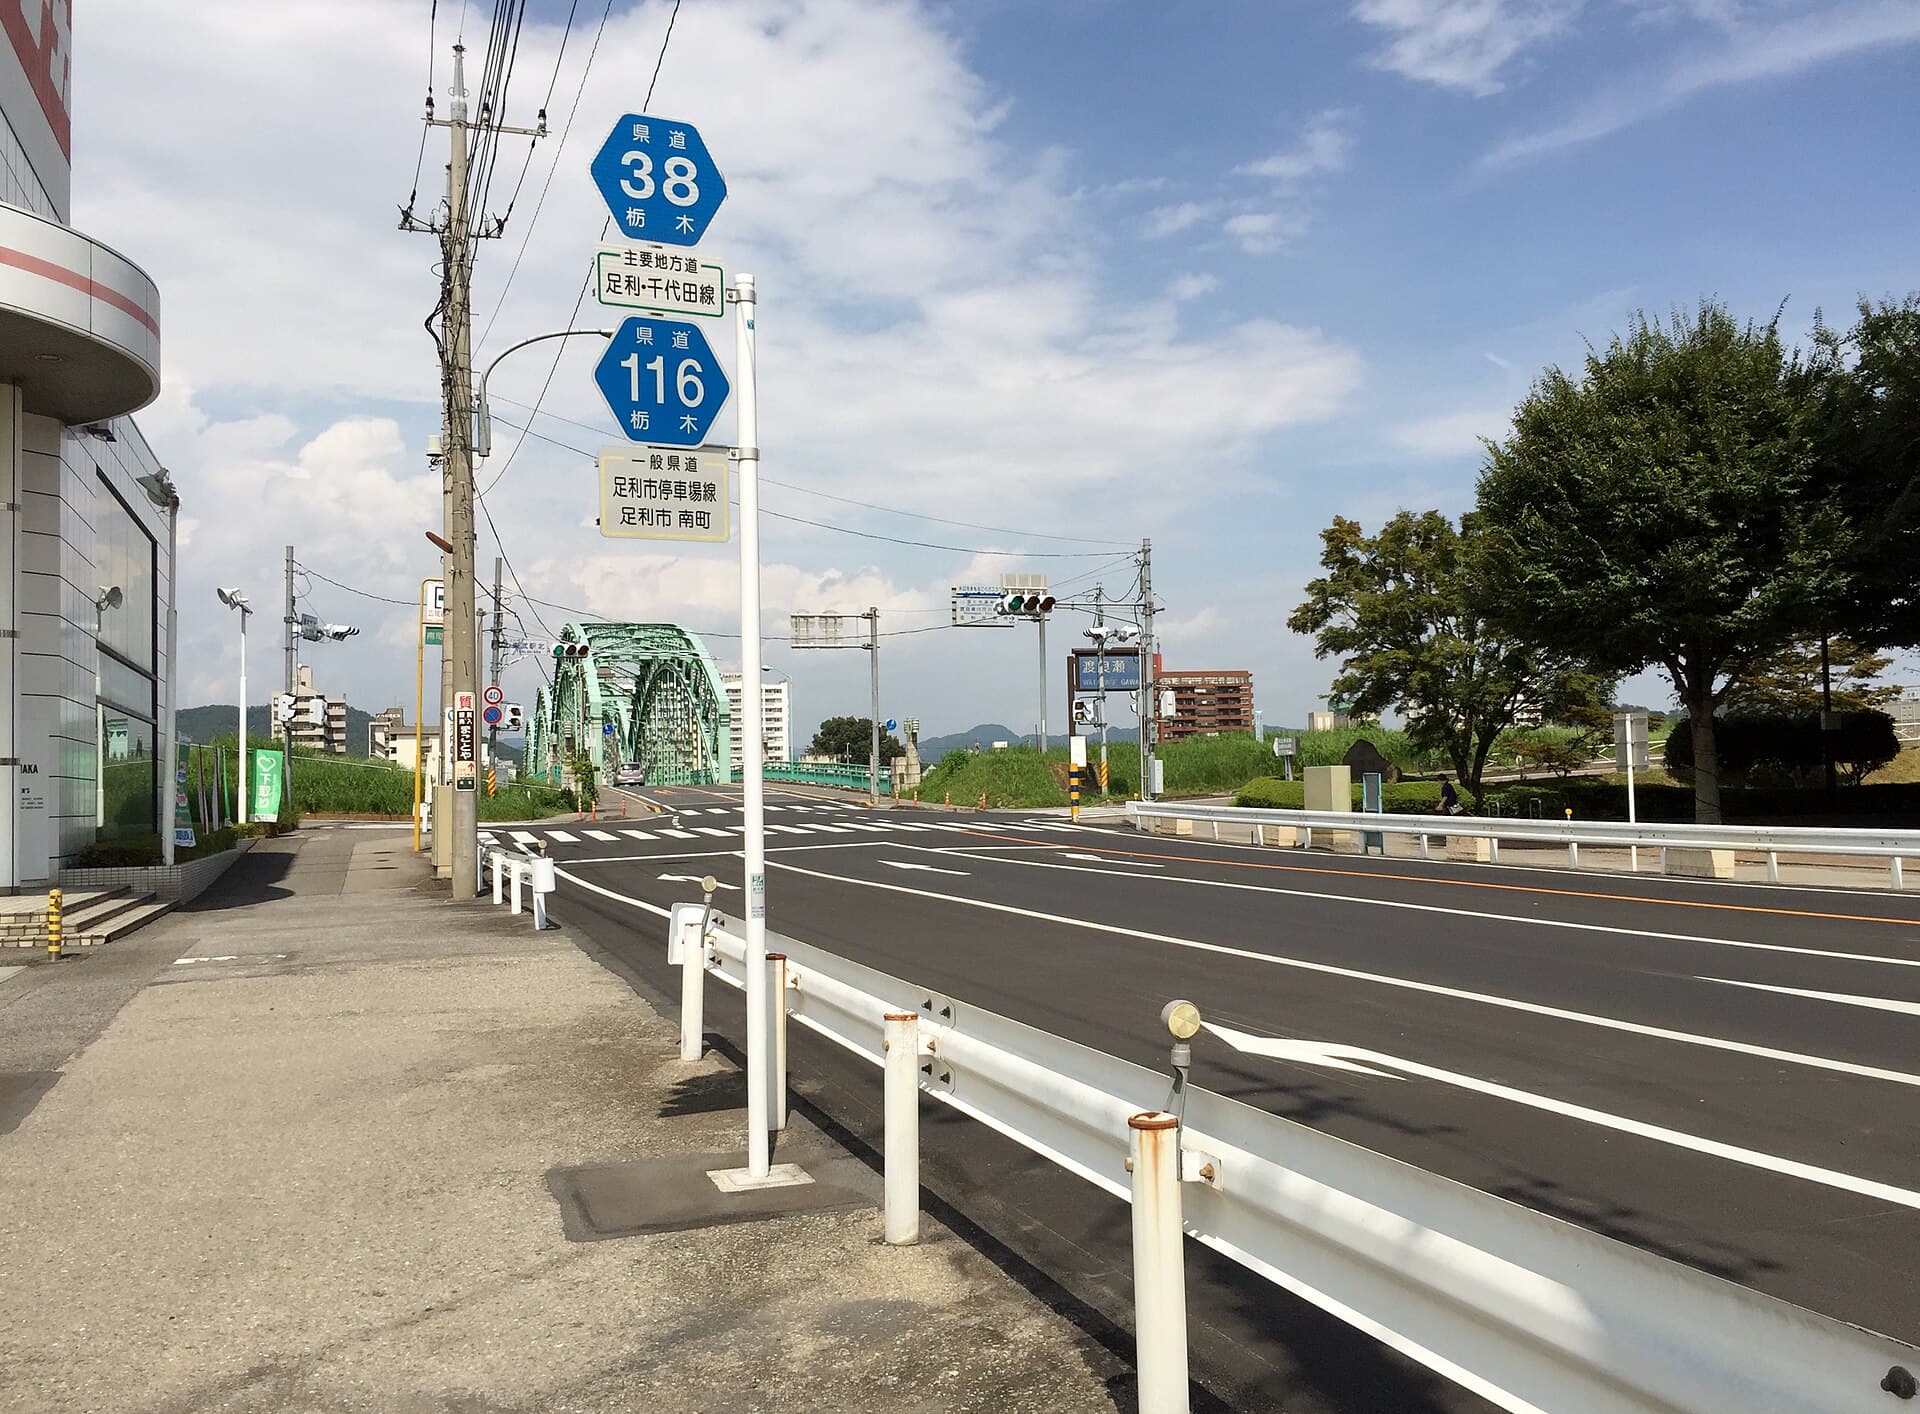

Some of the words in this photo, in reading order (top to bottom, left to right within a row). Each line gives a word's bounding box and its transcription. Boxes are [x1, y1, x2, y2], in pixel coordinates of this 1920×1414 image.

[632, 123, 687, 149] 県道
[619, 150, 700, 207] 38
[626, 207, 695, 235] 栃木
[623, 250, 699, 274] 主要地方道
[636, 327, 690, 350] 県道
[620, 352, 705, 408] 116
[630, 410, 698, 434] 栃木
[631, 454, 699, 472] 一般県道
[612, 476, 717, 502] 足利市停車場線
[488, 691, 499, 700] 40
